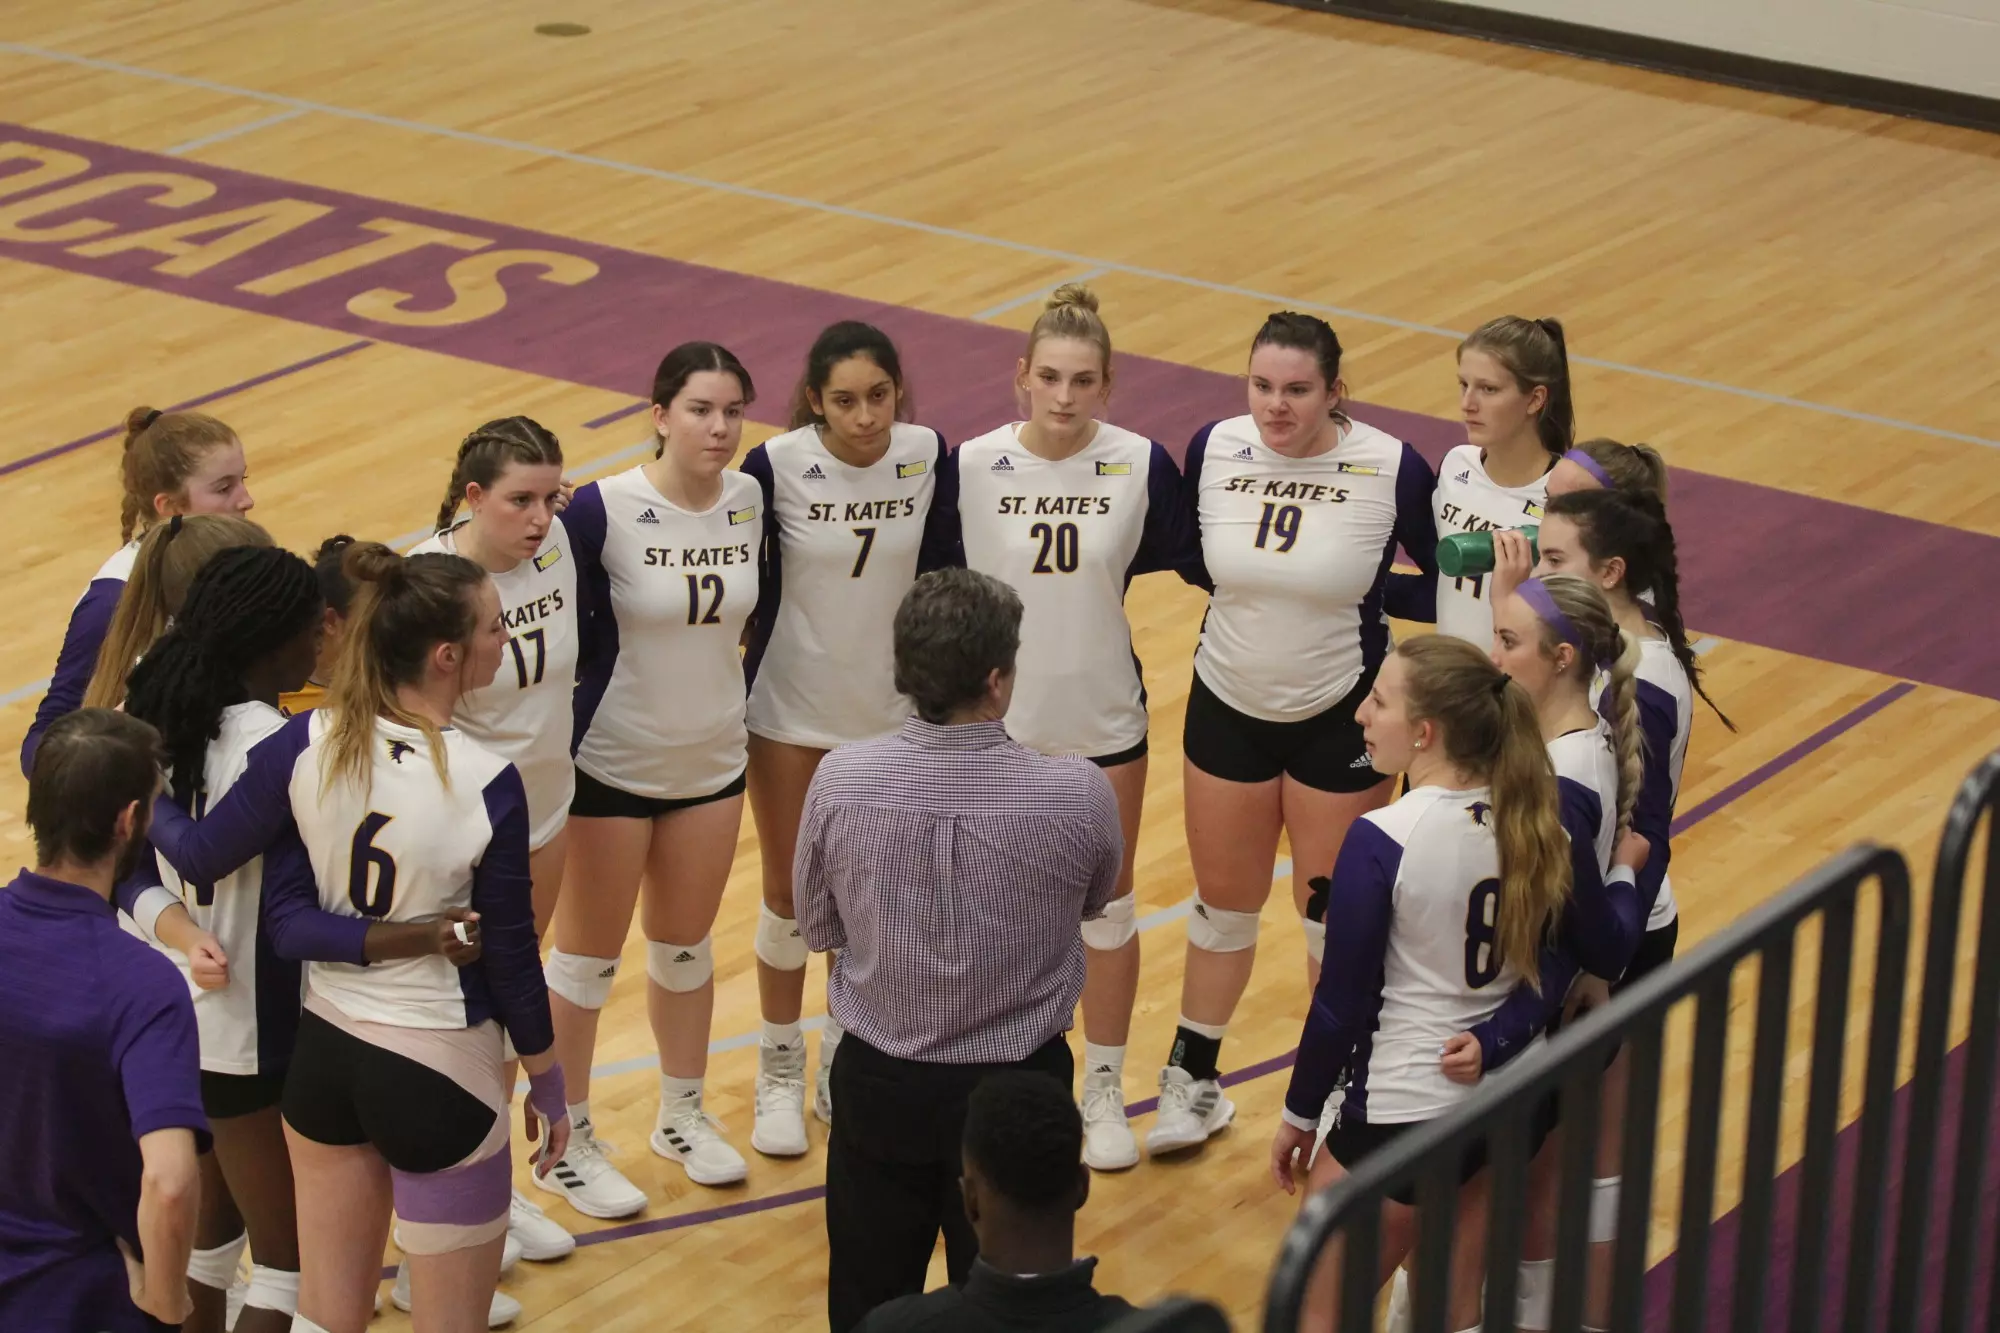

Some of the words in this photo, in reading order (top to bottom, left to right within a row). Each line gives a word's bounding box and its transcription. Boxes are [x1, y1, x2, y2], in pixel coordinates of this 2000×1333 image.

[991, 464, 1015, 472] adidas
[998, 497, 1027, 515] ST.
[1034, 497, 1111, 515] KATE'S
[1225, 478, 1256, 494] ST.
[1262, 480, 1350, 503] KATE'S
[636, 515, 660, 524] adidas
[808, 503, 837, 521] ST.
[844, 497, 915, 521] KATE'S
[1440, 502, 1462, 526] ST.
[1253, 502, 1303, 554] 19
[644, 547, 675, 566] ST.
[682, 543, 749, 566] KATE'S
[850, 527, 877, 578] 7
[1029, 522, 1080, 575] 20
[500, 588, 564, 629] KATE'S
[685, 573, 725, 626] 12
[508, 627, 546, 690] 17
[347, 809, 397, 919] 6
